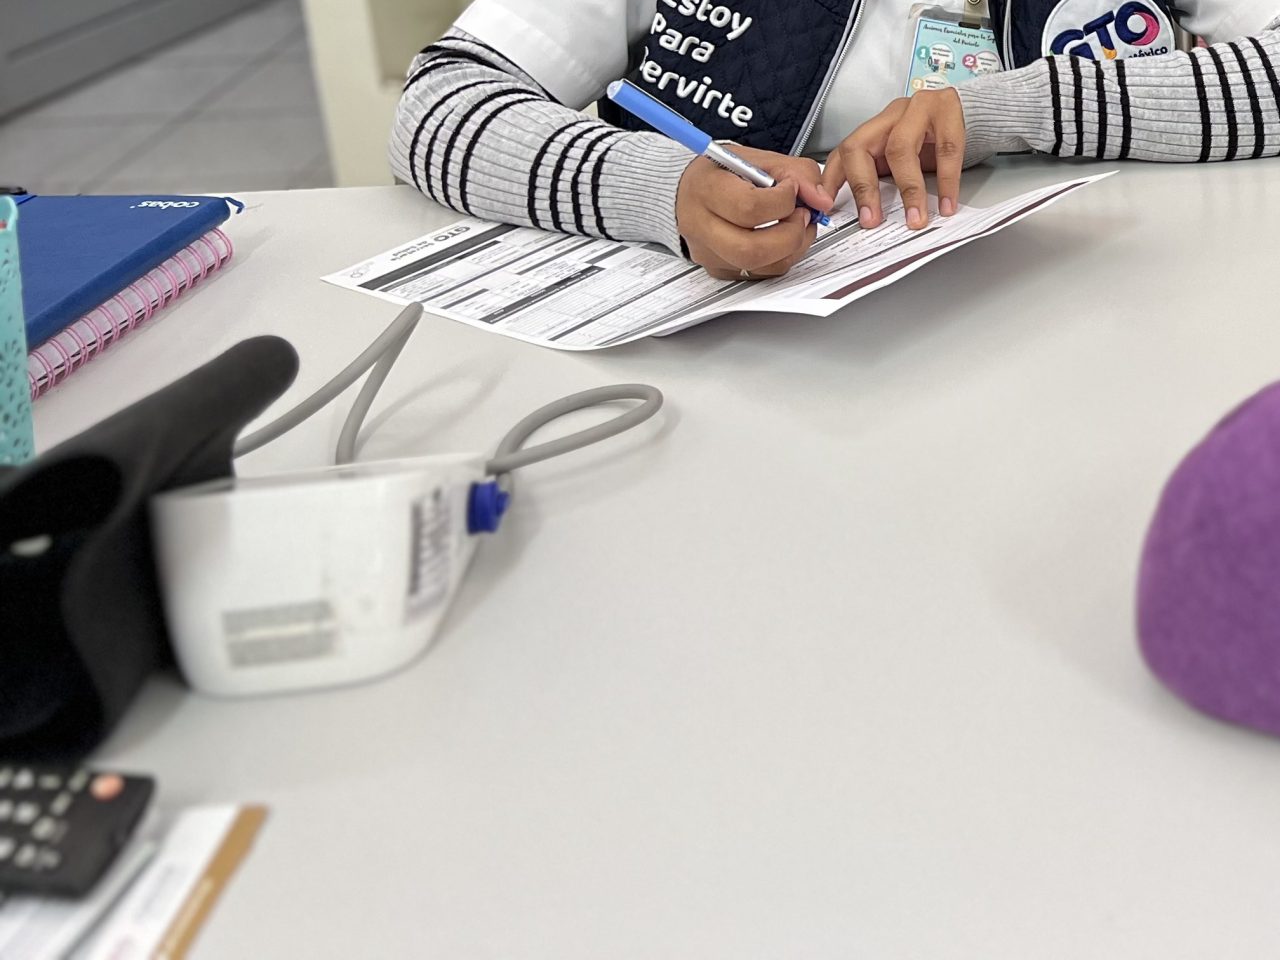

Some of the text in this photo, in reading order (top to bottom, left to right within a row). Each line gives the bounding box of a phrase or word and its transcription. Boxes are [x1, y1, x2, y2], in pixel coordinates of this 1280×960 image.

[651, 12, 715, 63] Para
[1050, 1, 1160, 60] GTO
[964, 56, 975, 66] 2
[639, 45, 753, 128] ervirte
[138, 200, 200, 210] cobas
[433, 226, 471, 242] GTO
